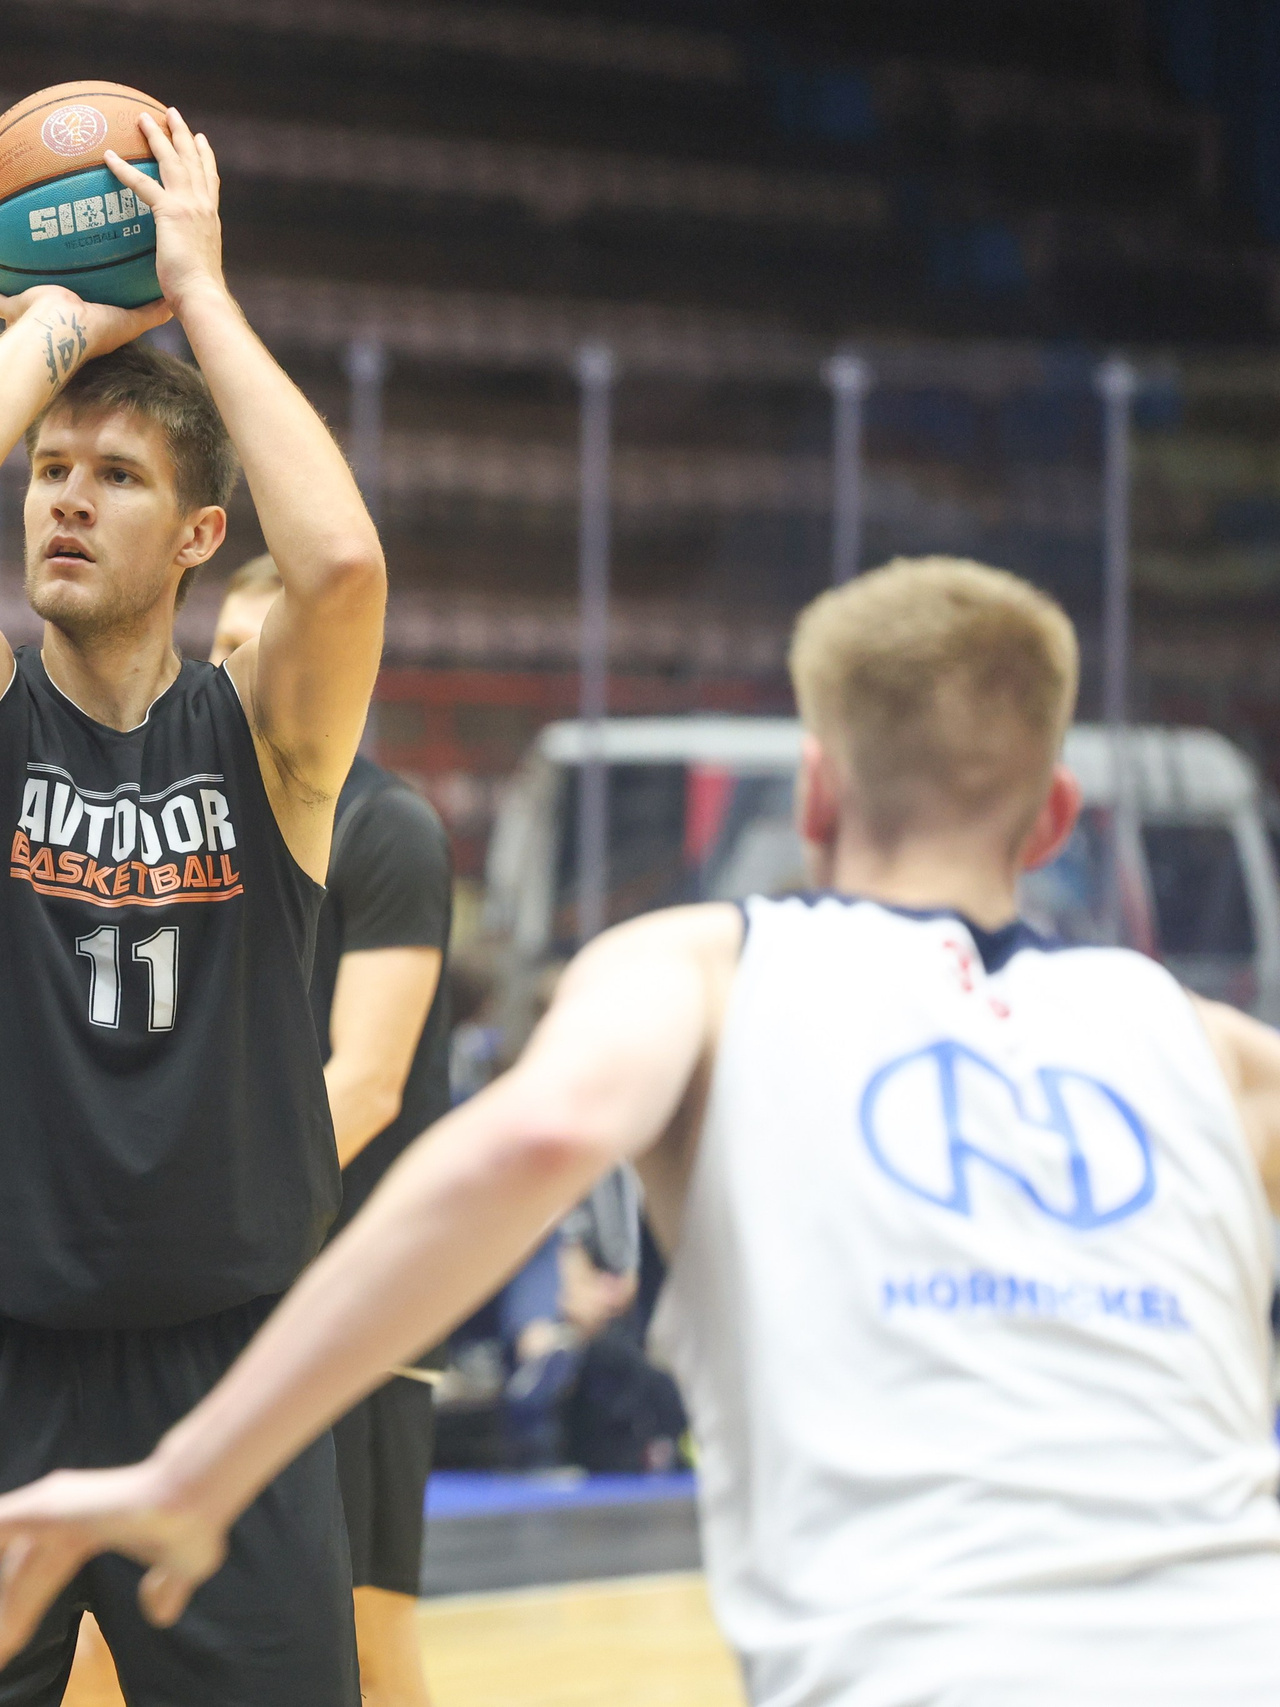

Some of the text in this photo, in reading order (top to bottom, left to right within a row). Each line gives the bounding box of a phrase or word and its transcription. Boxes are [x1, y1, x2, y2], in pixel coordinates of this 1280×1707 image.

[122, 223, 141, 237] 2.0
[17, 777, 237, 865] AVTODOR
[10, 830, 240, 896] BASKETBALL
[75, 925, 179, 1032] 11
